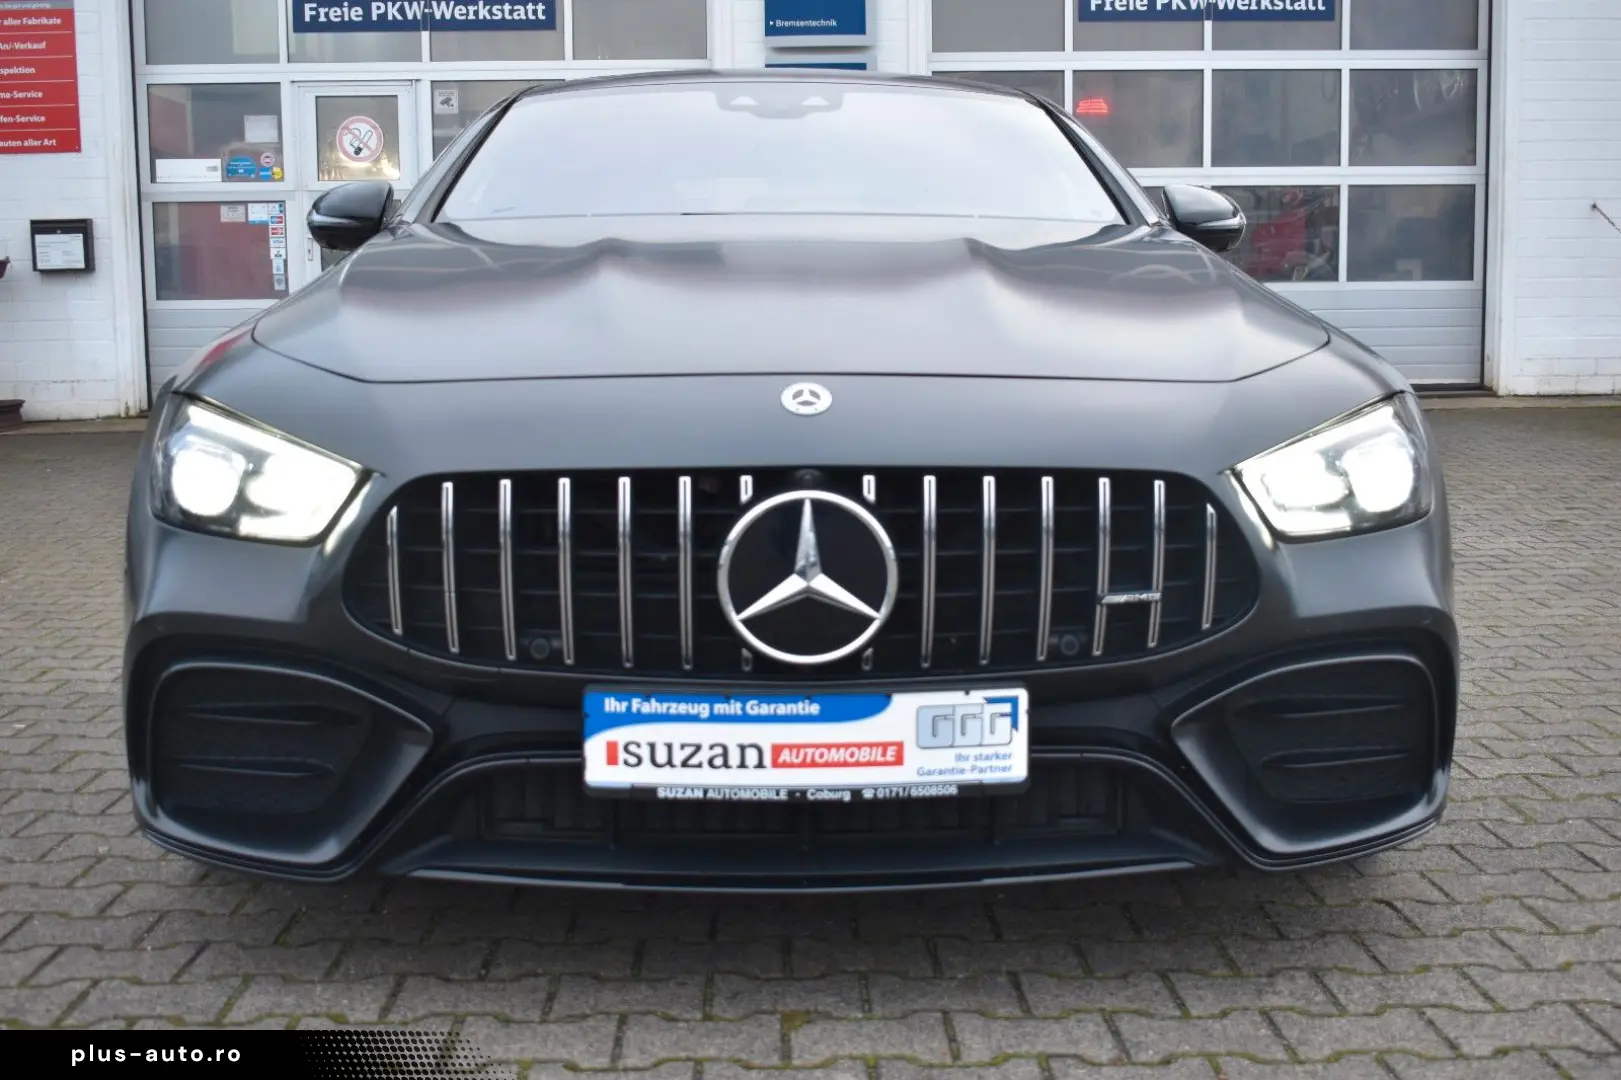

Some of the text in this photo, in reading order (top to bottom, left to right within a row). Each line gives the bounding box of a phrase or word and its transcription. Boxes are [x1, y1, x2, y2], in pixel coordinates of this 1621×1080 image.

[304, 0, 546, 22] Freie PKW-Werkstatt
[3, 17, 62, 25] aller Fabrikate
[776, 19, 838, 27] Bremsentechnik
[23, 138, 42, 147] aller
[44, 138, 57, 146] Art
[604, 697, 821, 719] Ihr Fahrzeug mit Garantie
[622, 739, 898, 770] suzan AUTOMOBILE
[954, 750, 1013, 763] Ihr starker
[916, 764, 1013, 777] Garantie-Partner
[657, 786, 704, 799] SUZAN
[705, 787, 789, 800] AUTOMOBILE
[806, 788, 851, 802] Coburg
